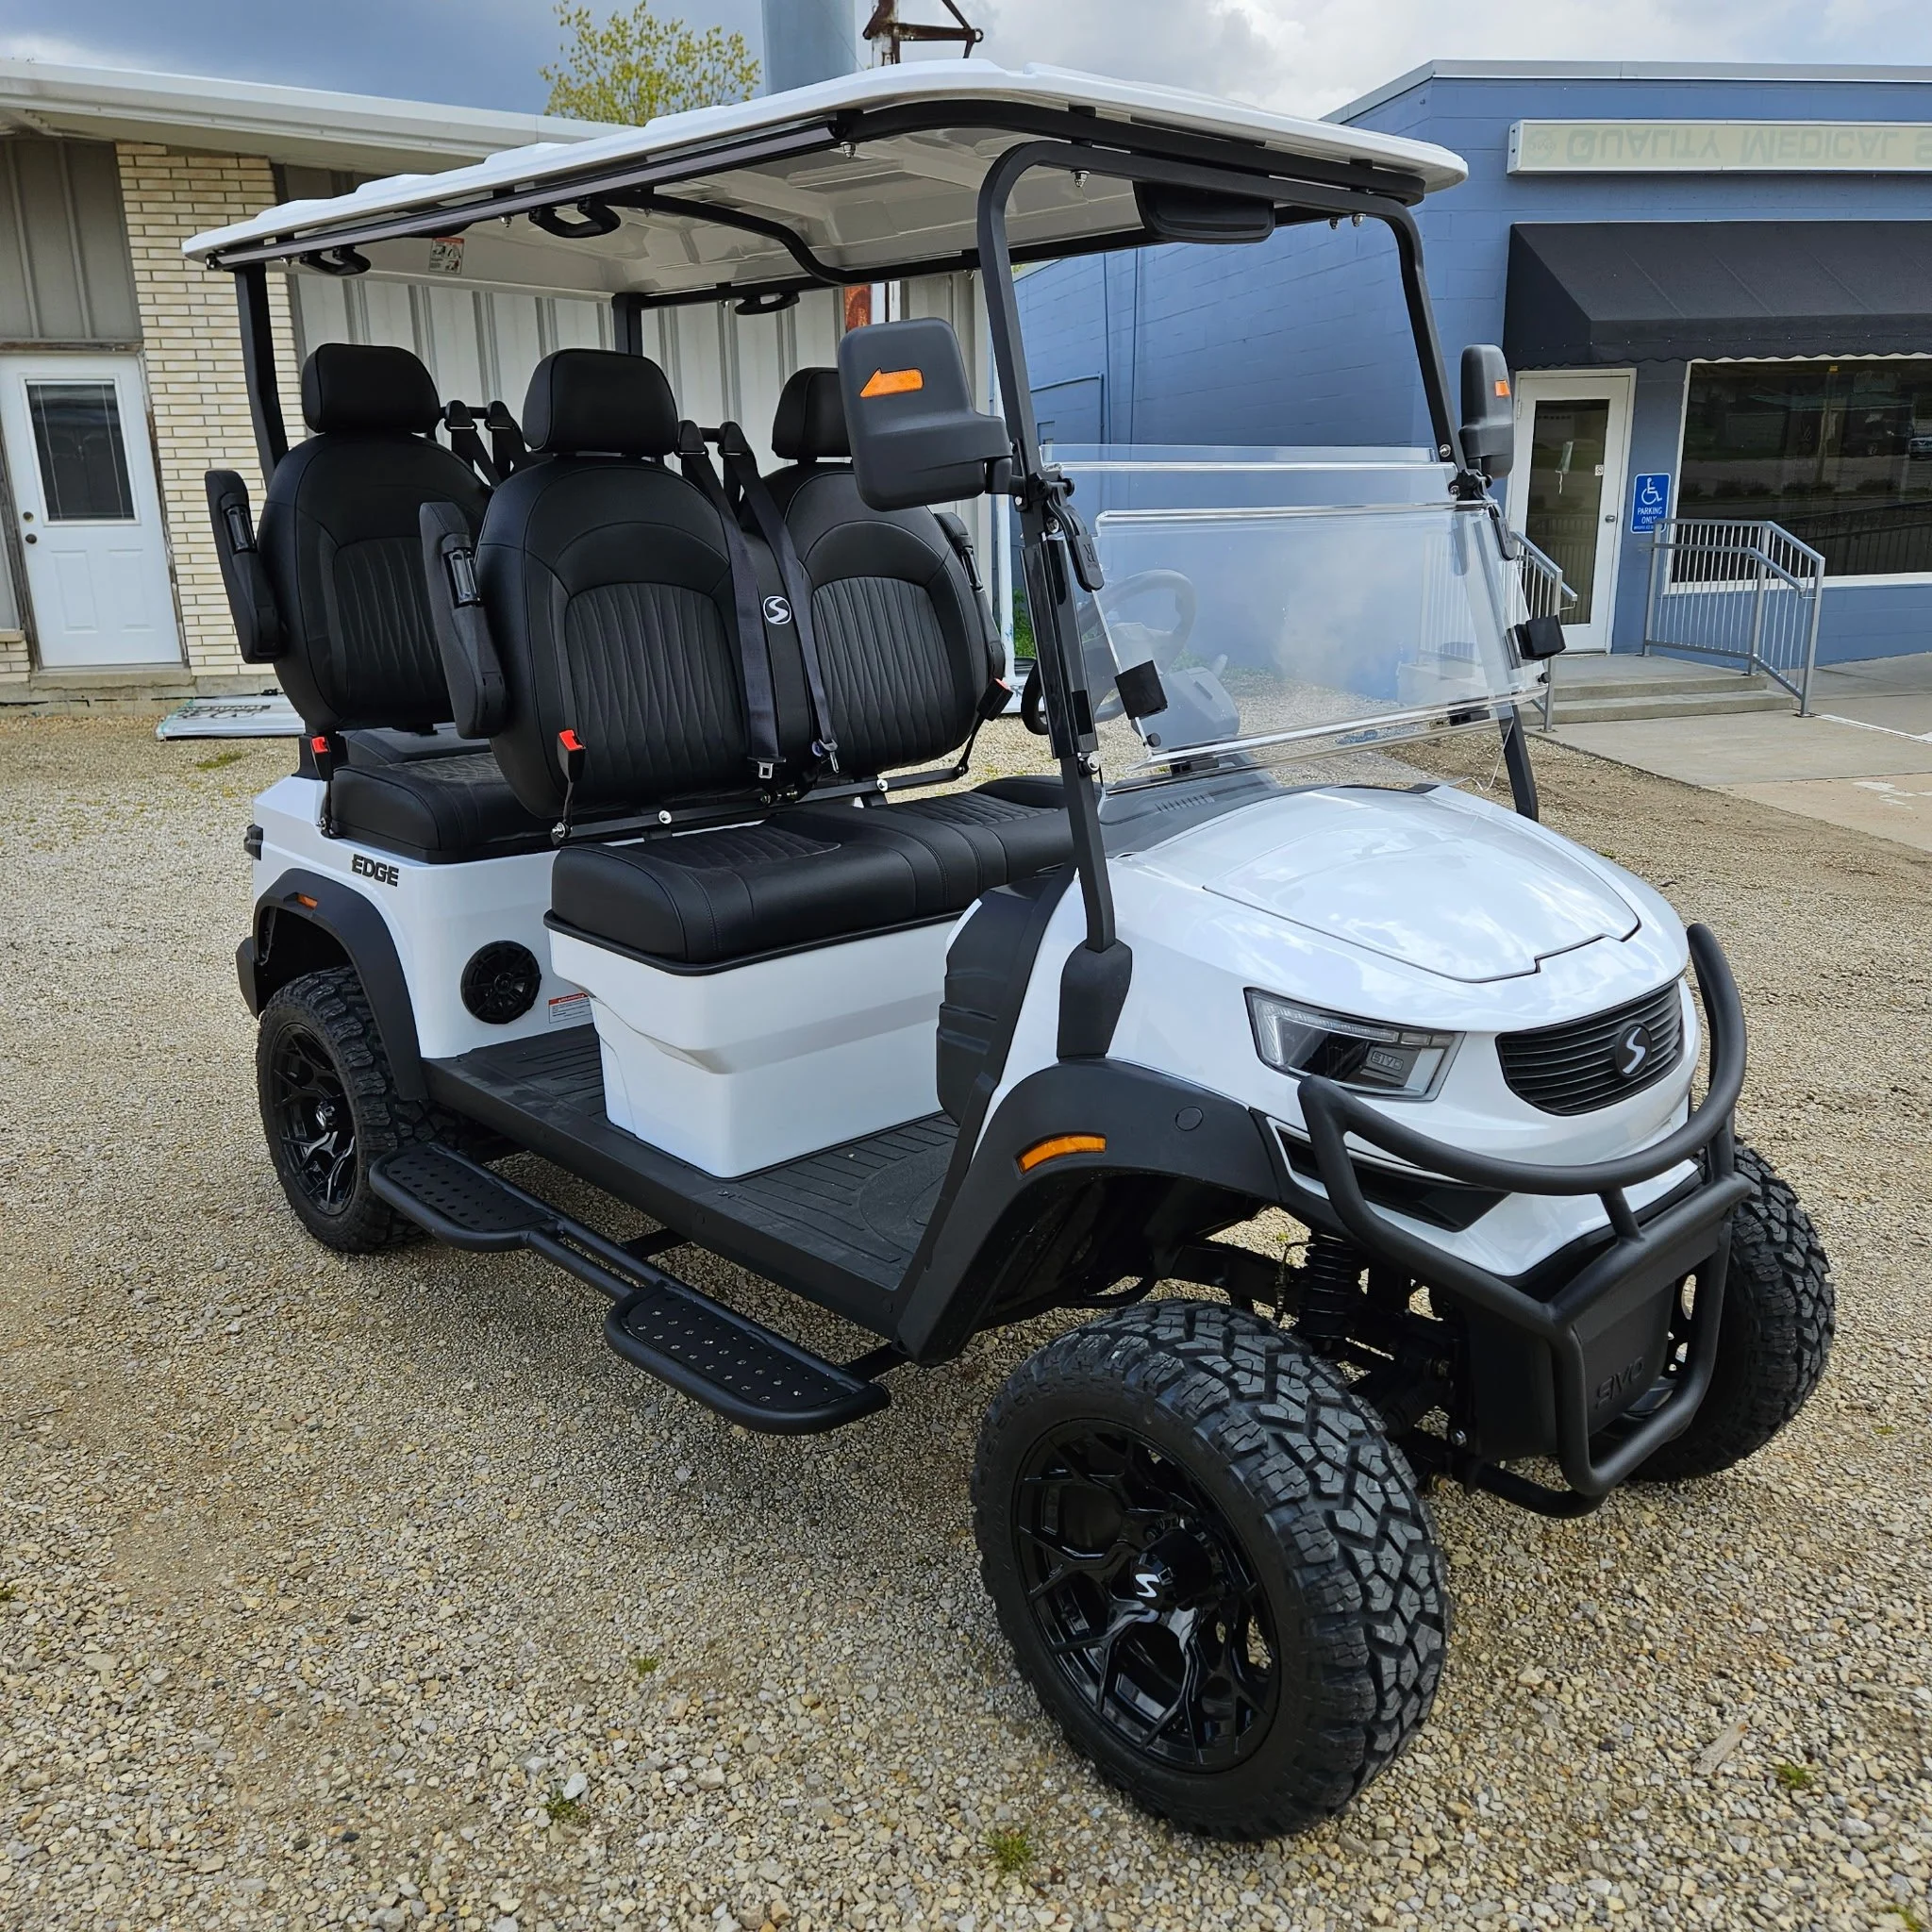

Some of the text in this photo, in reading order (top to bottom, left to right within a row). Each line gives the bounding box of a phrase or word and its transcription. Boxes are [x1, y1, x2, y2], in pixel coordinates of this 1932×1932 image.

[1637, 507, 1663, 515] PARKING
[351, 853, 399, 888] EDGE
[1594, 1356, 1645, 1410] SIVO
